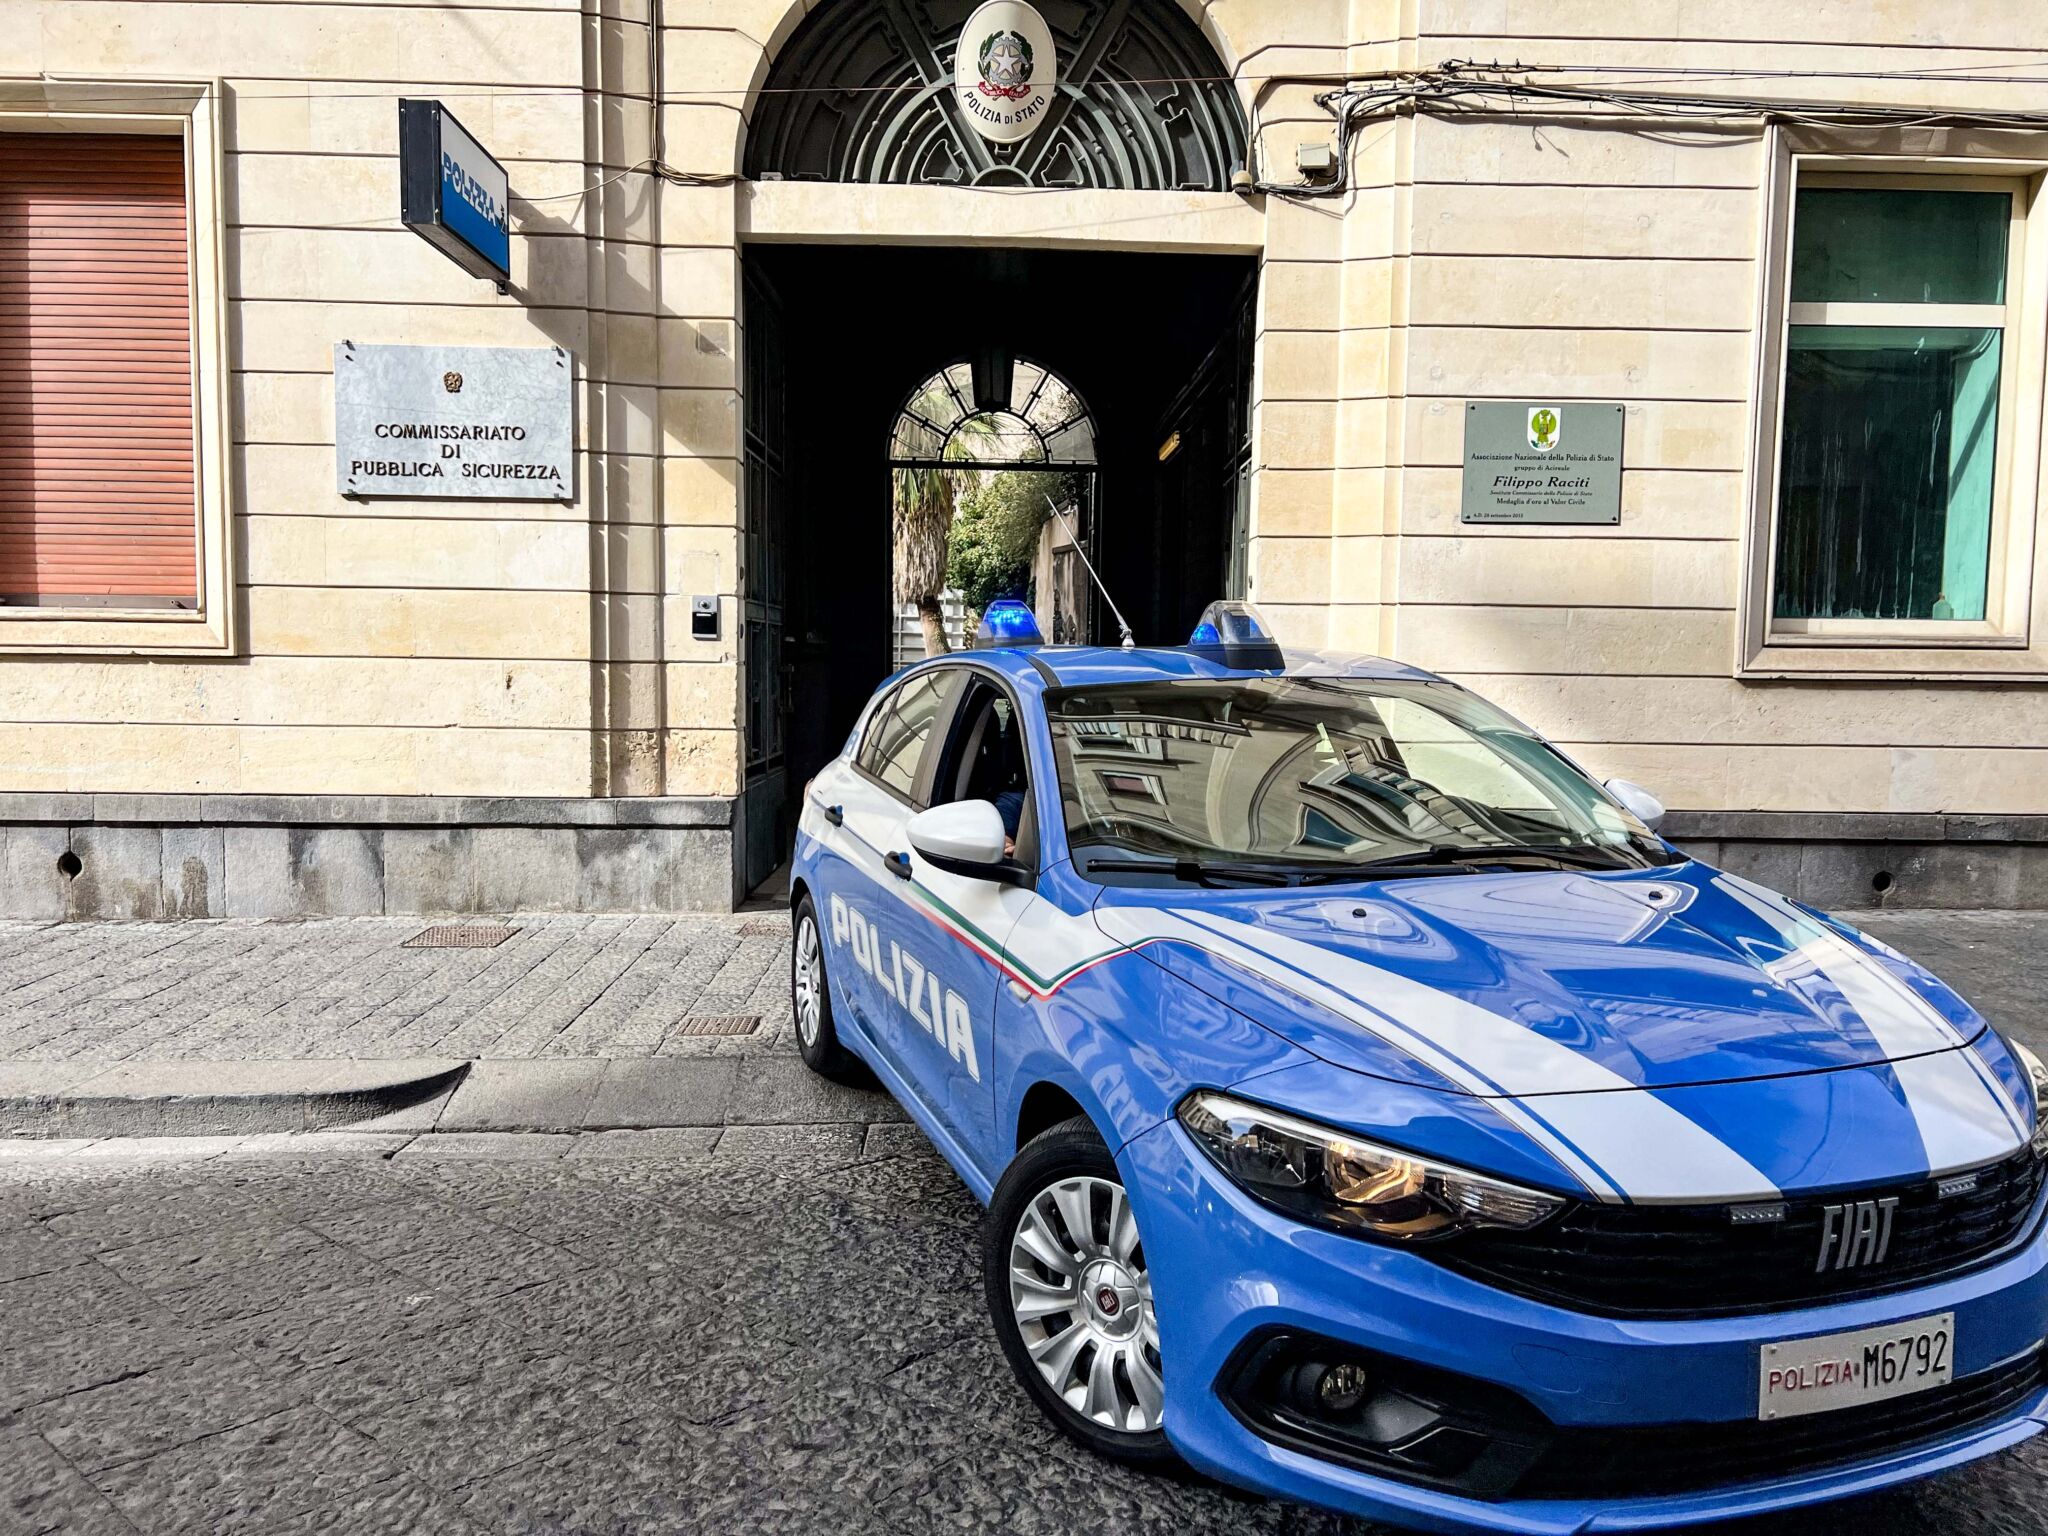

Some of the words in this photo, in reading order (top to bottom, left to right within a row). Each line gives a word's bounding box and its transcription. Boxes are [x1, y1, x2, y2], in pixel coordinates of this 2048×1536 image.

[964, 91, 1001, 124] POLIZIA
[1015, 95, 1045, 123] STATO
[443, 151, 497, 228] POLIZIA
[375, 424, 526, 441] COMMISSARIATO
[441, 444, 460, 459] DI
[1548, 453, 1564, 461] della
[351, 461, 444, 477] PUBBLICA
[461, 463, 561, 480] SICUREZZA
[1493, 475, 1543, 489] Filippo
[1547, 476, 1590, 488] Raciti
[831, 892, 980, 1083] POLIZIA
[1816, 1197, 1899, 1273] FIAT
[1768, 1360, 1853, 1394] POLIZIA
[1863, 1330, 1948, 1389] M6792
